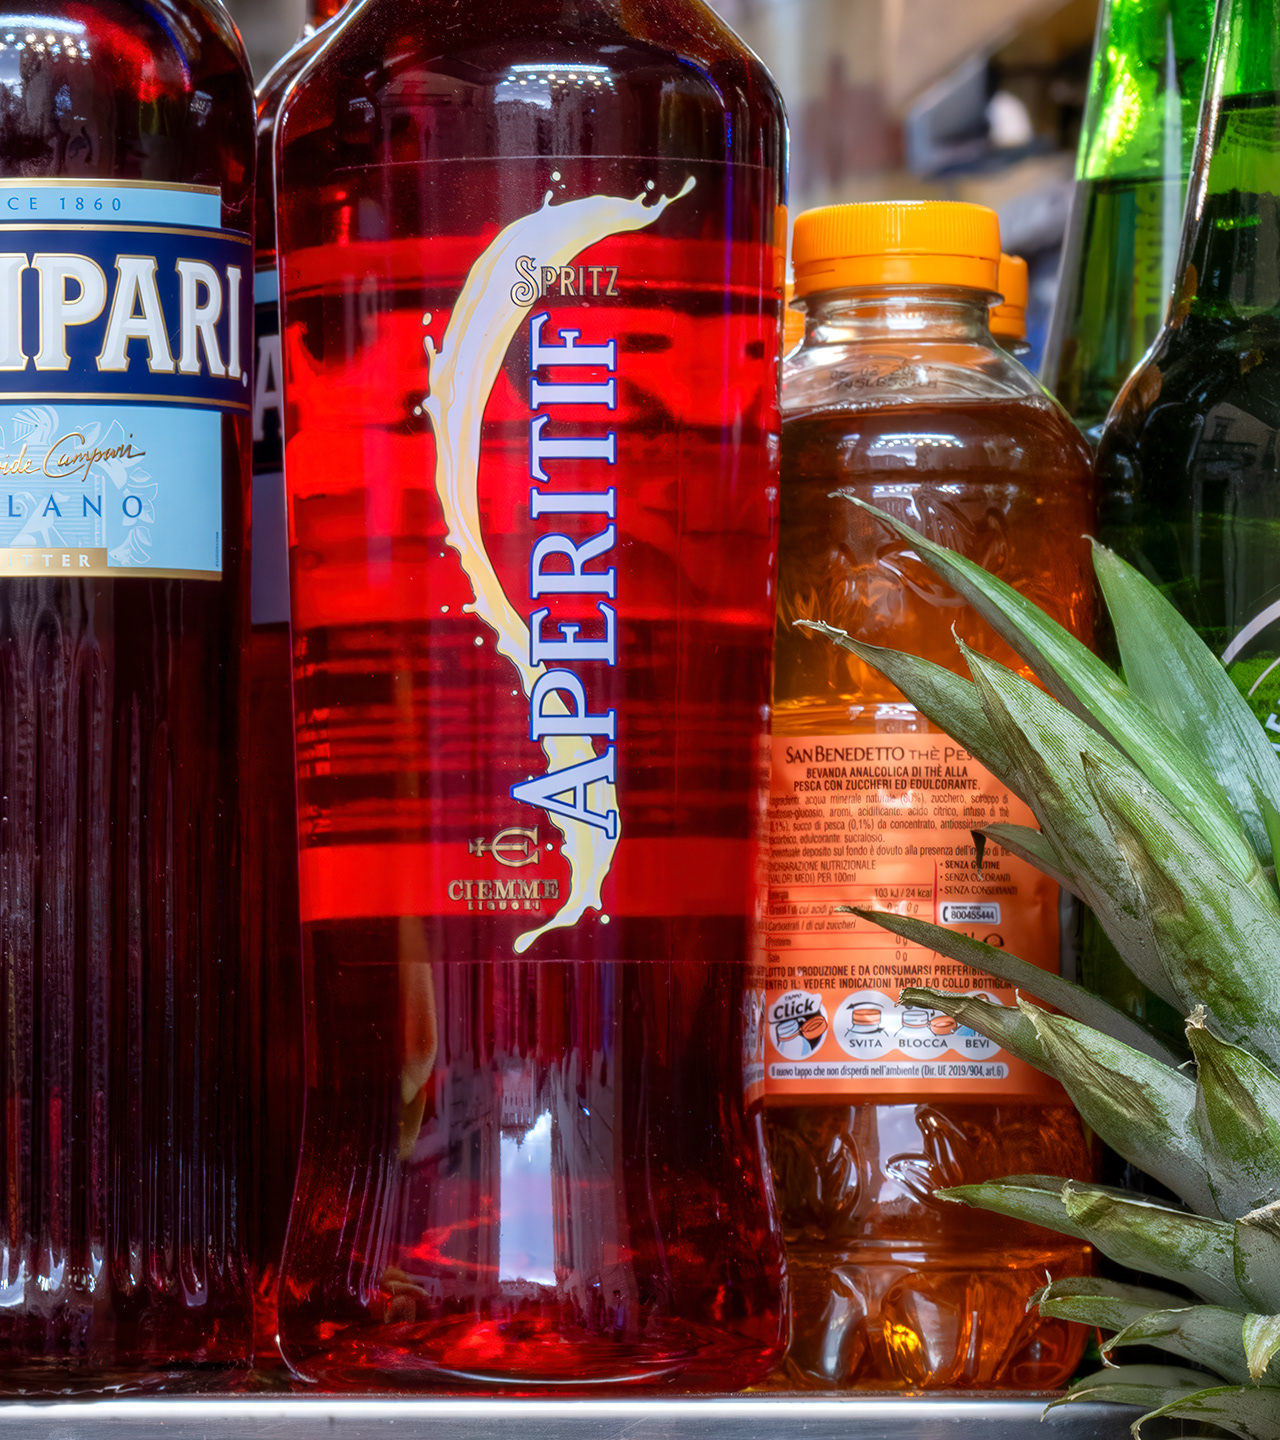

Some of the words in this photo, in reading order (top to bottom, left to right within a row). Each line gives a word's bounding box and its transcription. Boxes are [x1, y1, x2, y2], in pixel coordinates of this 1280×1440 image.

[59, 195, 124, 213] 1860
[509, 253, 620, 307] SPRITZ
[42, 432, 147, 482] Campari
[510, 310, 619, 840] APERITIF
[806, 766, 848, 779] BEVANDA
[849, 766, 909, 778] ANALCOLICA
[911, 766, 922, 777] DI
[924, 764, 942, 777] THÈ
[944, 766, 968, 778] ALLA
[793, 780, 821, 792] PESCA
[824, 780, 843, 791] CON
[845, 780, 892, 791] ZUCCHERI
[895, 779, 908, 790] ED
[910, 779, 981, 791] EDULCORANTE.
[448, 879, 559, 900] CIEMME
[839, 977, 891, 989] INDICAZIONI
[894, 976, 922, 988] TAPPO
[942, 976, 970, 988] COLLO
[774, 997, 815, 1020] Click
[849, 1038, 883, 1048] SVITA
[898, 1038, 949, 1048] BLOCCA
[965, 1038, 990, 1049] BEVI
